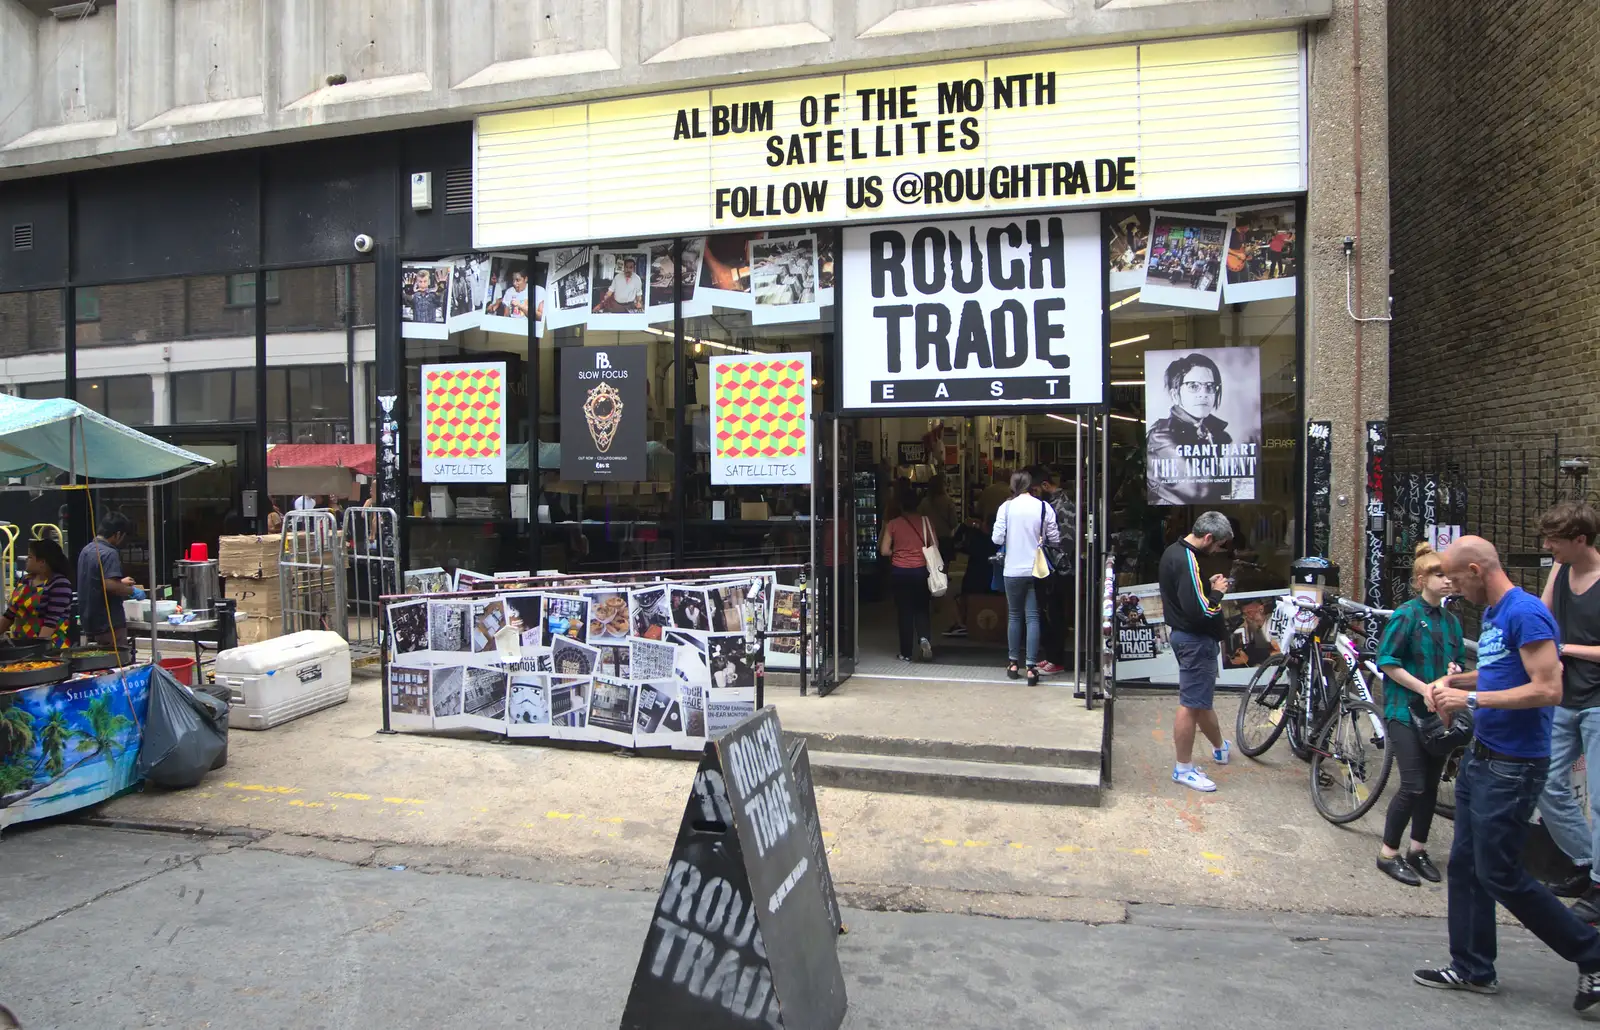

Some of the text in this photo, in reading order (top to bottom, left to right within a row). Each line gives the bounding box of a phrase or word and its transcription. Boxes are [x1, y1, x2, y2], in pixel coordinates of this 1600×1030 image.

[673, 72, 1057, 141] ALBUM OF THE MONTH
[766, 118, 980, 167] SATELLITES
[715, 156, 1137, 219] FOLLOW US @ROUGHTRADE
[870, 217, 1066, 298] ROUGH
[872, 297, 1070, 373] TRADE
[578, 370, 629, 380] SLOW FOCUS
[883, 378, 1059, 399] EAST
[1176, 443, 1257, 457] GRANT HART
[434, 463, 494, 476] SATELLITES
[725, 463, 797, 477] SATELLITES
[1152, 457, 1257, 478] THE ARGUMENT
[1119, 629, 1153, 641] ROUGH
[1120, 641, 1154, 654] TRADE
[729, 717, 784, 800] ROUGH
